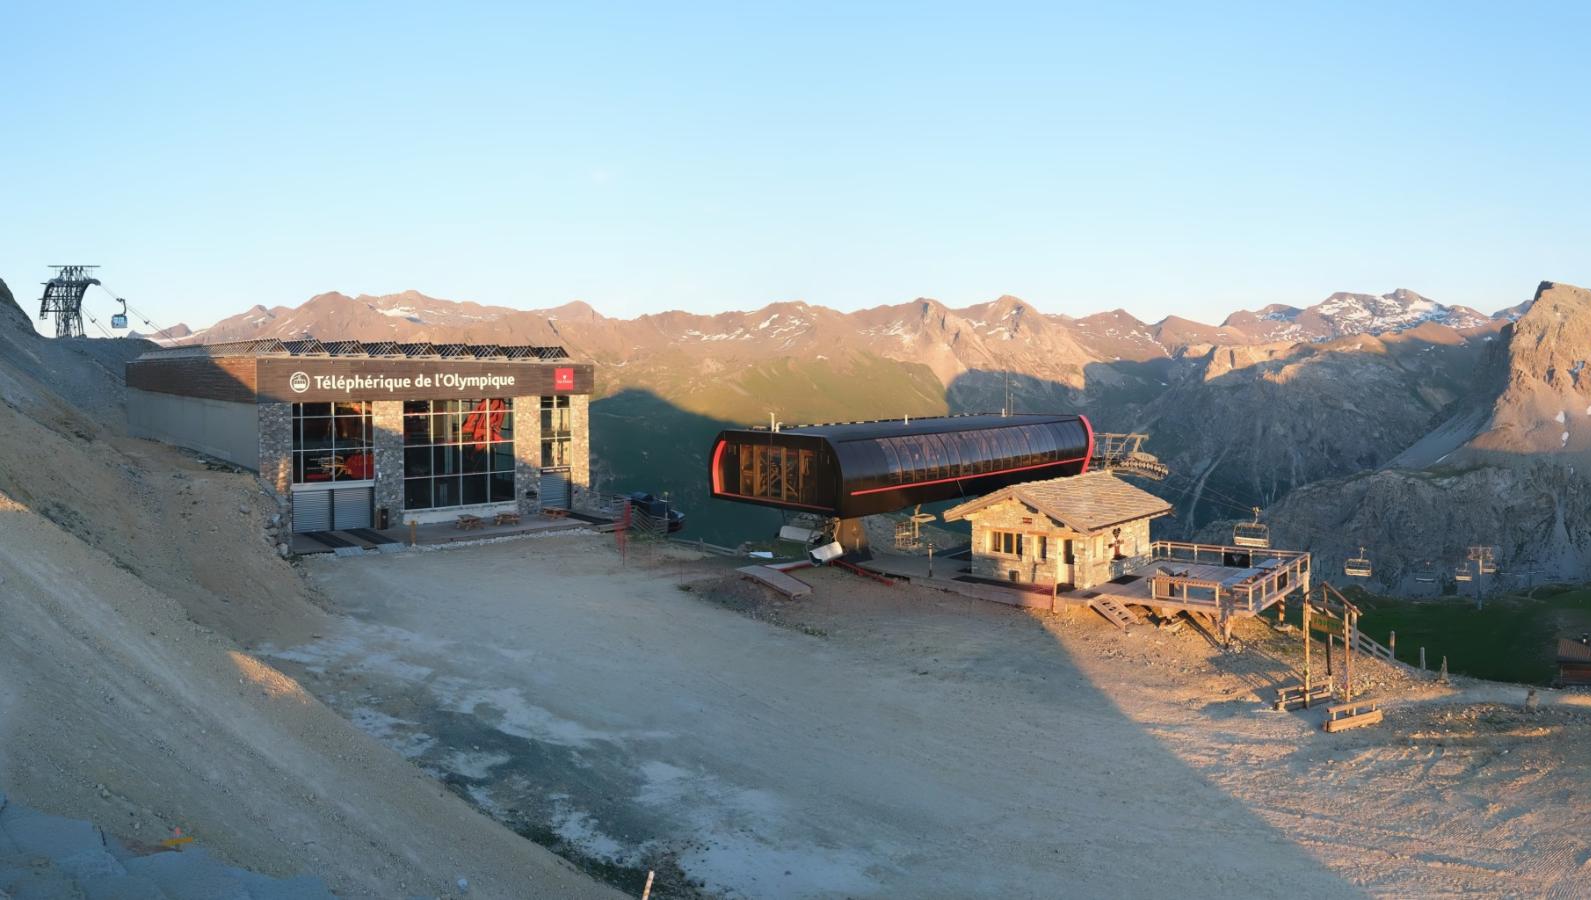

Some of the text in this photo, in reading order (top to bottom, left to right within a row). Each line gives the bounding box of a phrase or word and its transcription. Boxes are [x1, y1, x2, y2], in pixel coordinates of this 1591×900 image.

[314, 374, 515, 393] Téléphérique de l'Olympique
